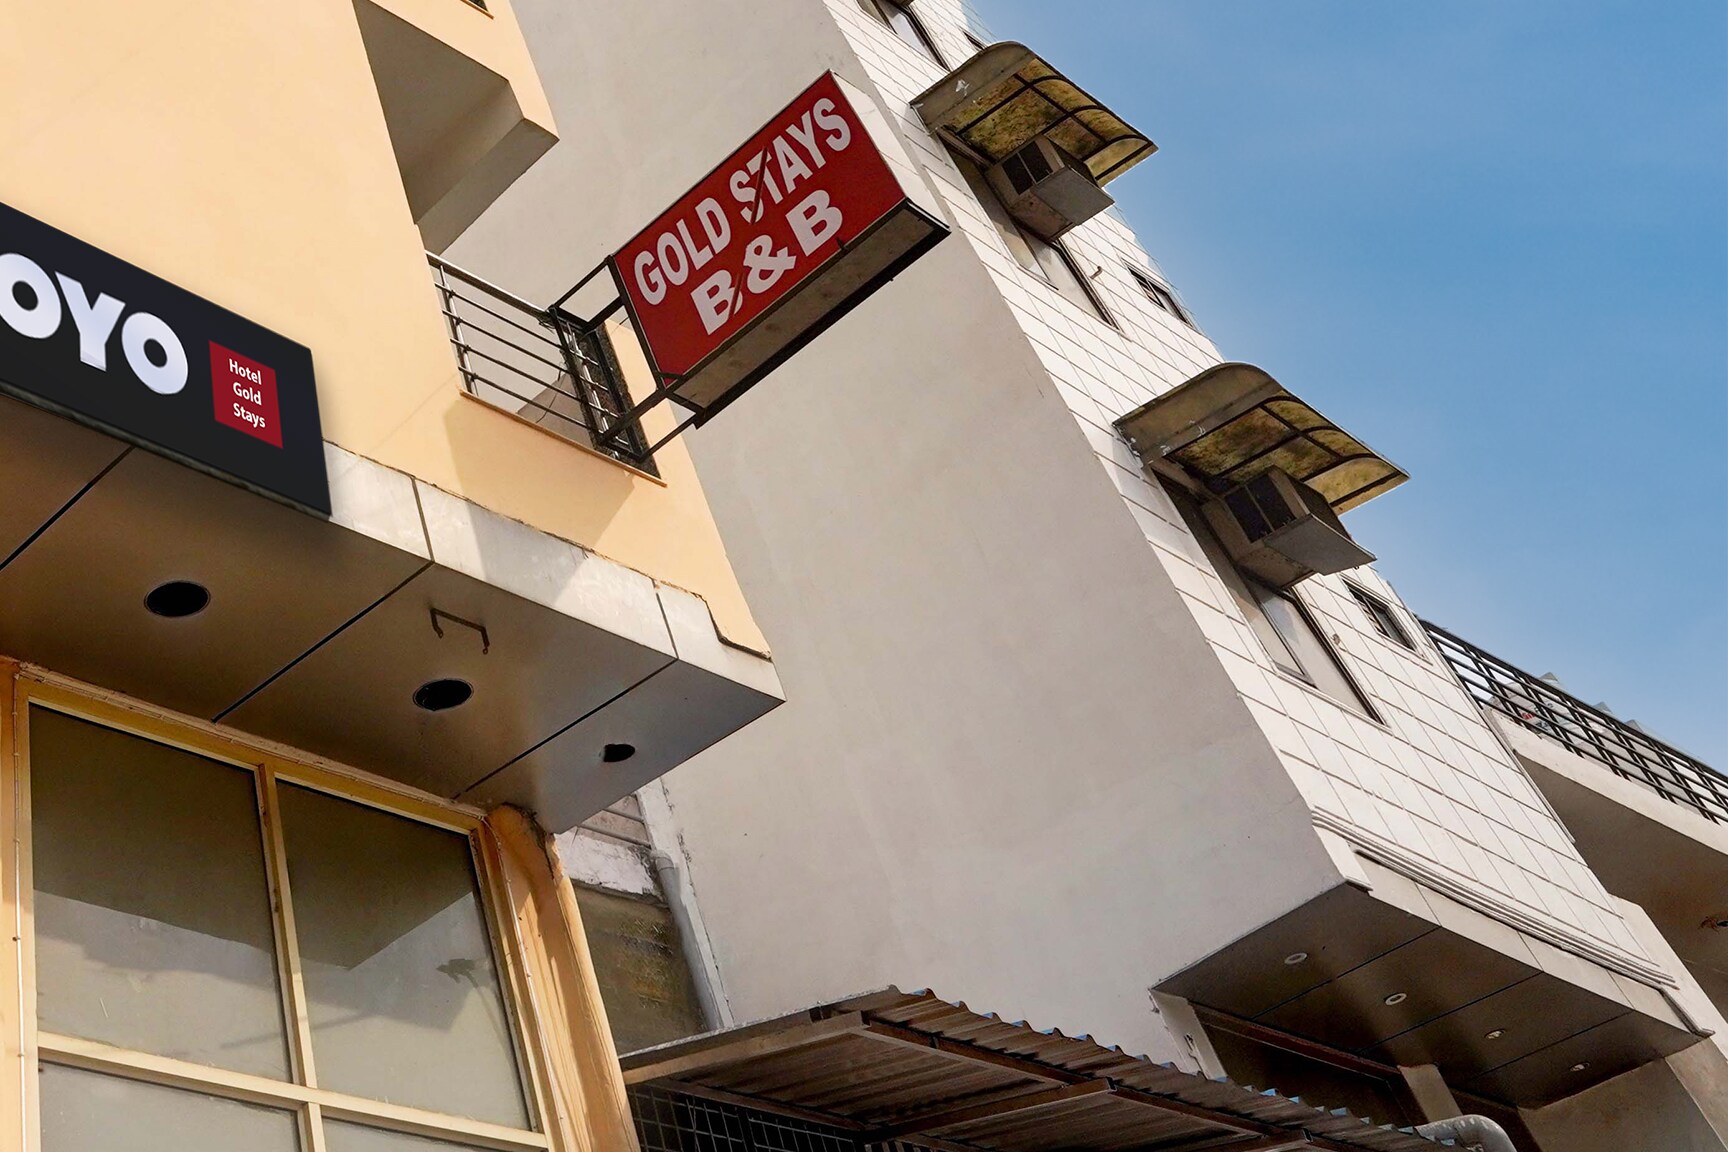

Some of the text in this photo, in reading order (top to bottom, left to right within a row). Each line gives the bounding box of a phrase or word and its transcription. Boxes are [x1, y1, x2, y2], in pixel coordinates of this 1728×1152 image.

[634, 97, 851, 306] GOLD STAYS
[690, 189, 843, 336] B&B
[228, 358, 262, 385] Hotel
[232, 381, 262, 406] Gold
[232, 402, 266, 428] Stays
